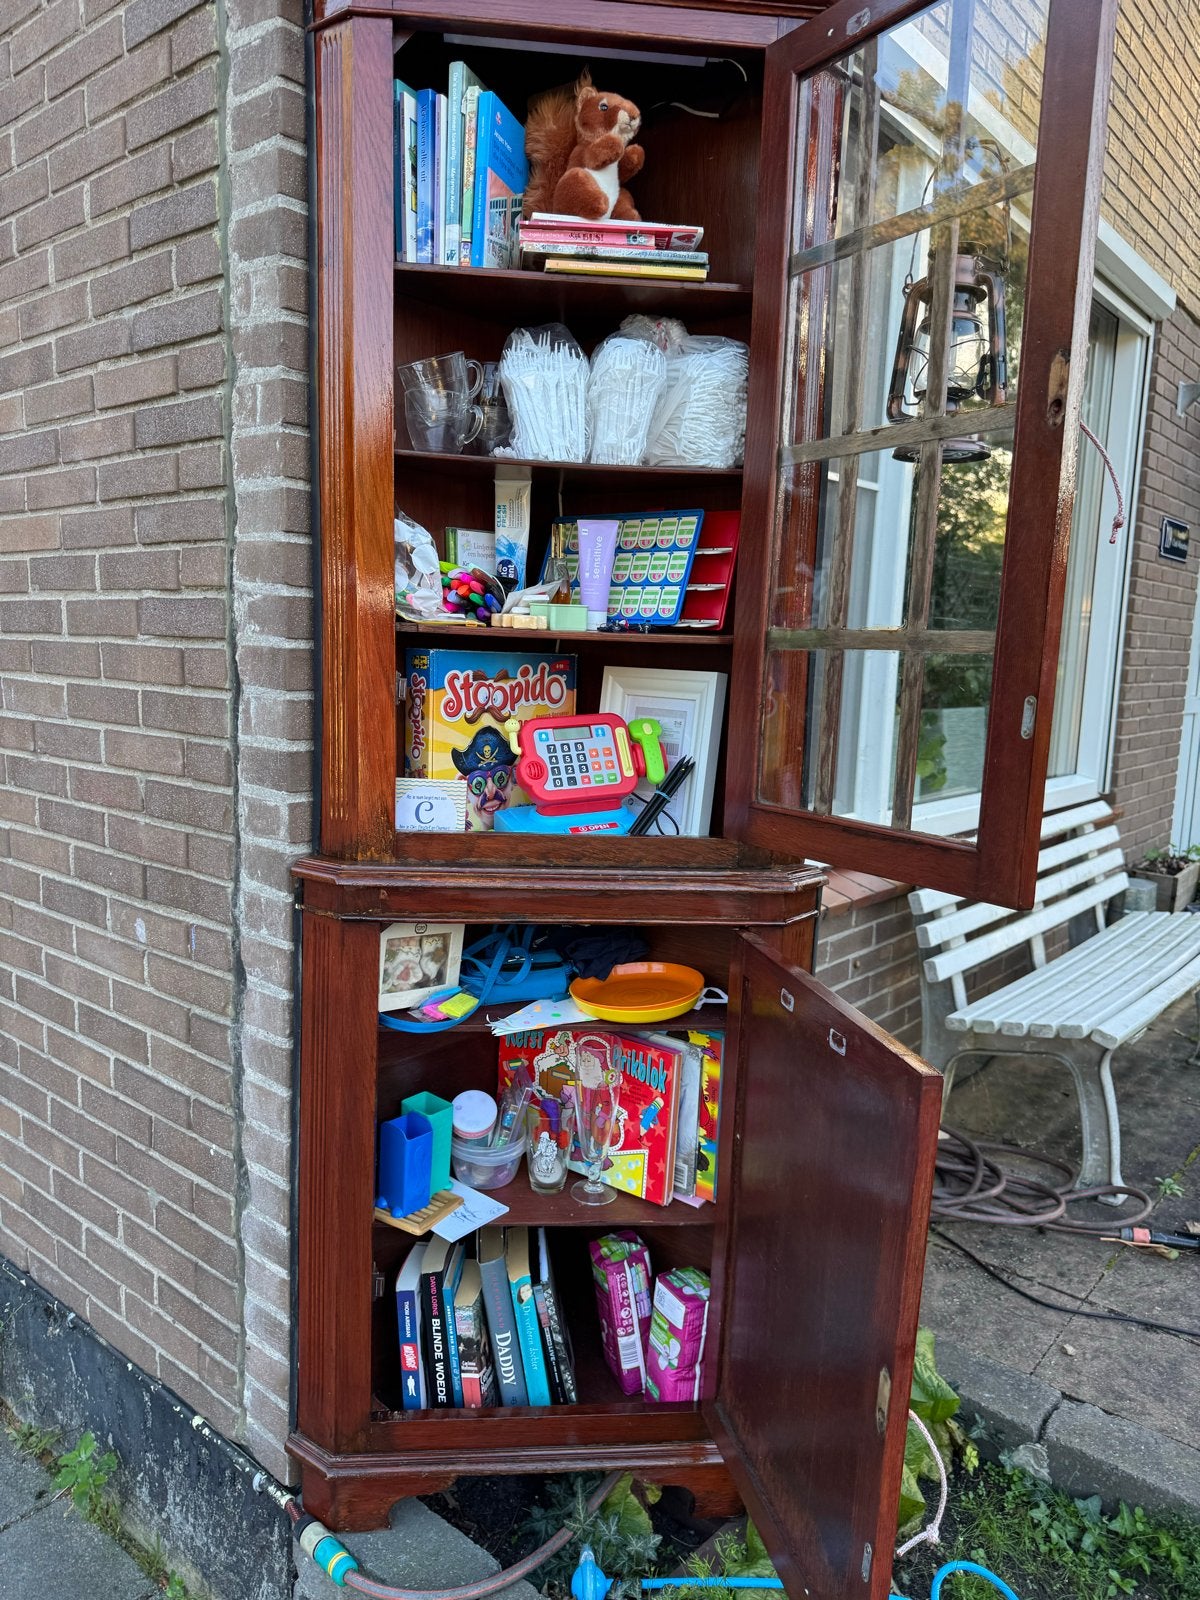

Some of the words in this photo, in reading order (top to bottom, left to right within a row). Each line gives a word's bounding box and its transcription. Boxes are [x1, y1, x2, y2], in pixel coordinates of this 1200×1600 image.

[592, 535, 603, 579] sensitive
[442, 662, 566, 721] Stoopido
[411, 673, 426, 759] Stoopido
[589, 823, 610, 831] OPEN
[505, 1031, 545, 1049] Kerst
[612, 1044, 668, 1094] Prikblok
[429, 1276, 438, 1296] DAVID
[431, 1296, 439, 1316] LORNE
[432, 1318, 444, 1360] BLINDE
[494, 1330, 517, 1386] DADDY
[435, 1362, 447, 1404] WOEDE
